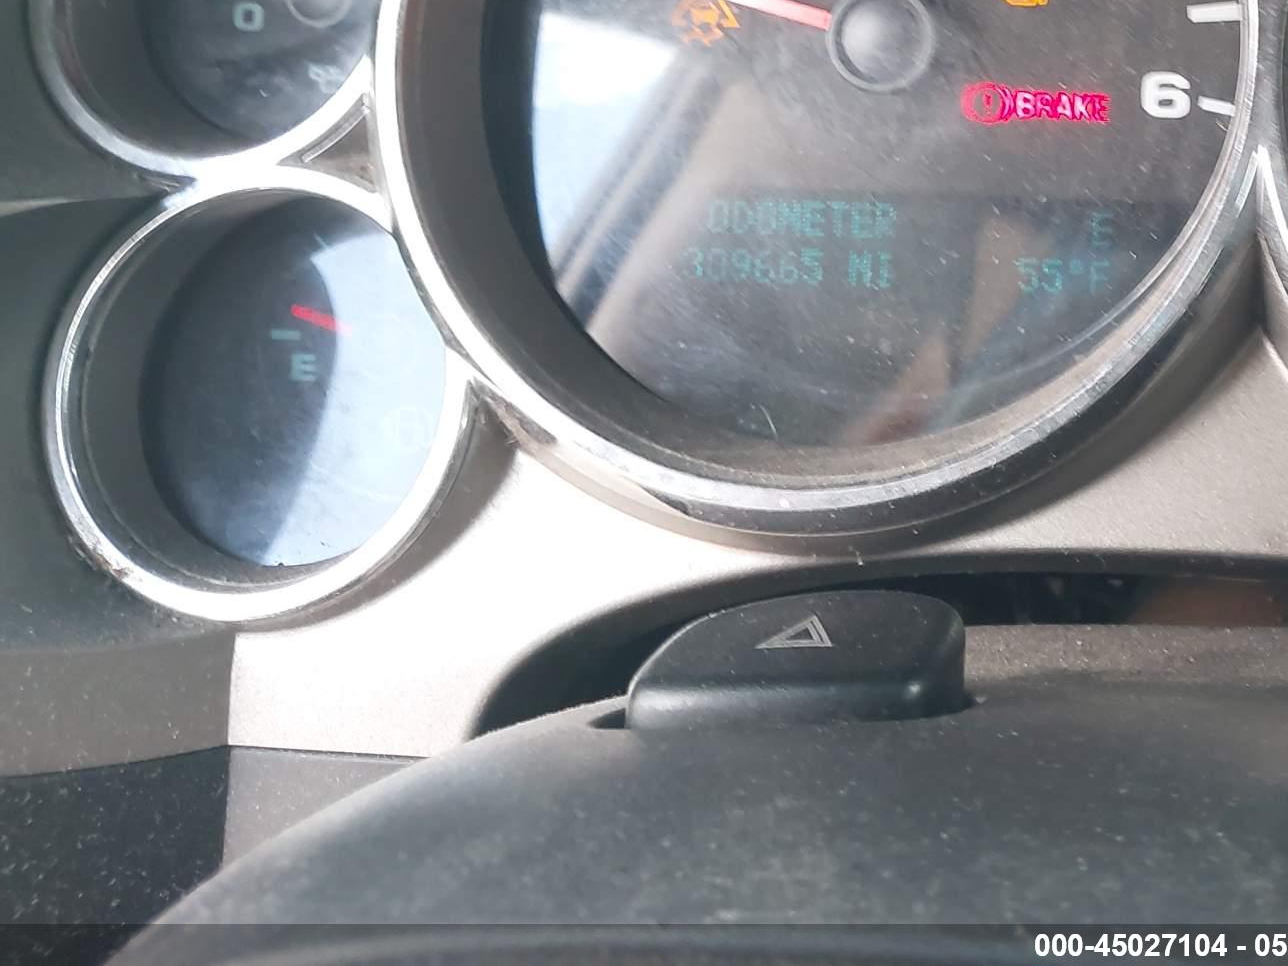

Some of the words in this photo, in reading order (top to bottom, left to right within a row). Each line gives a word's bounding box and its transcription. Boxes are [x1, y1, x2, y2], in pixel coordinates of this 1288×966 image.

[232, 0, 264, 31] 0
[1013, 89, 1110, 123] BRAKE
[1141, 71, 1191, 119] 6
[709, 200, 897, 238] ODOMETER
[291, 353, 316, 381] E
